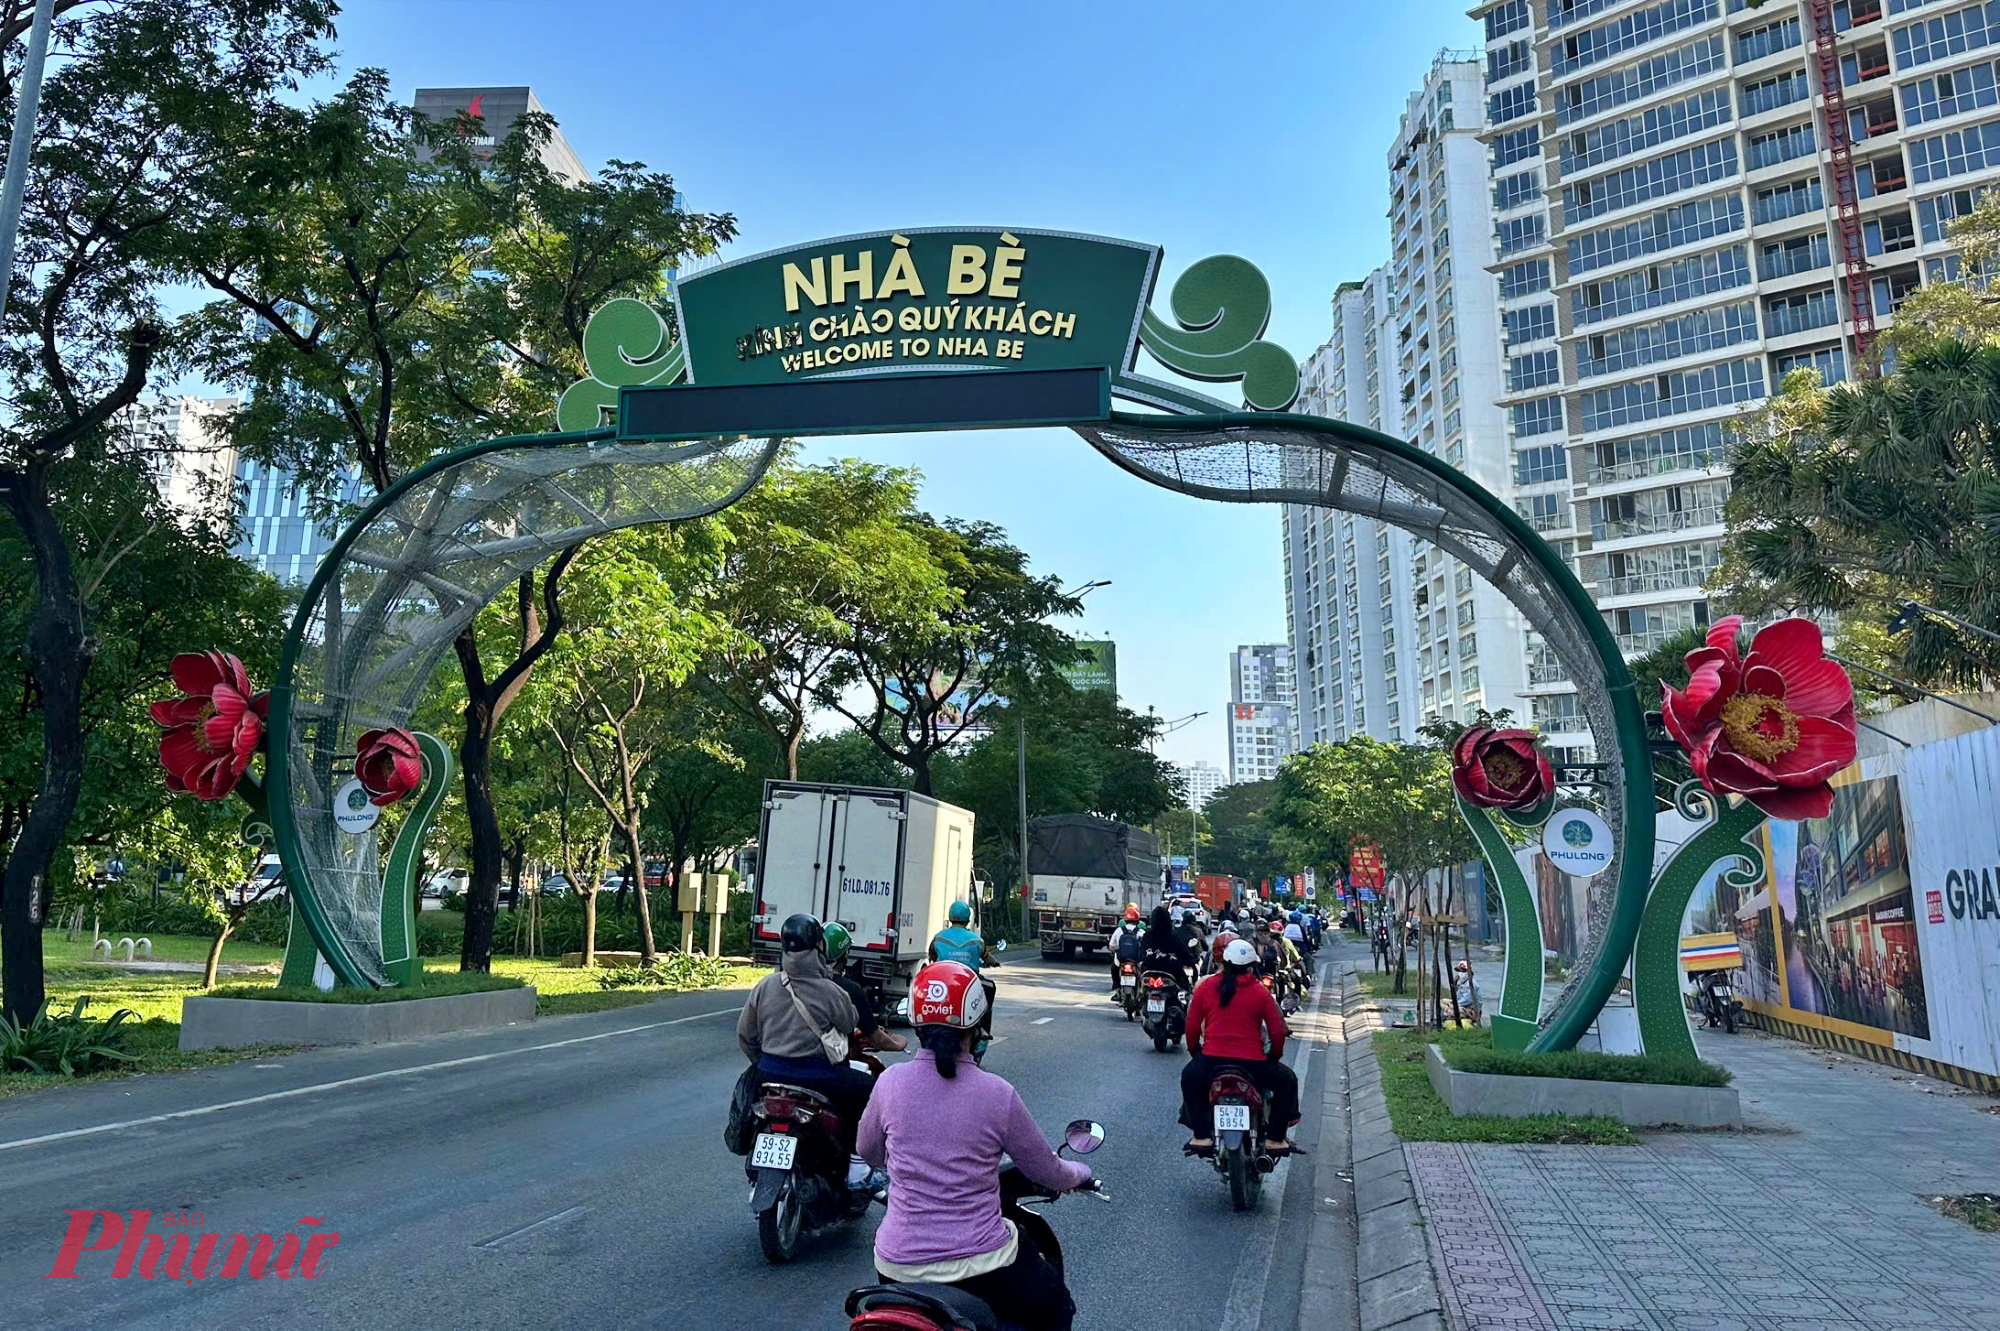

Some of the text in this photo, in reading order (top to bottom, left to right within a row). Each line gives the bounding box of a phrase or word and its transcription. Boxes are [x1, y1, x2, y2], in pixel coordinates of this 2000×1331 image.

[783, 231, 1026, 312] NHÀ BÈ
[809, 305, 893, 341] CHÀO
[899, 298, 961, 331] QUÝ
[964, 301, 1076, 339] KHÁCH
[781, 338, 1024, 373] WELCOME TO NHA BE
[338, 814, 374, 822] PHULONG
[1551, 851, 1605, 860] PHULONG
[1219, 1107, 1244, 1117] 54-Z8
[1219, 1118, 1244, 1128] 6854
[762, 1137, 791, 1152] 59-S2
